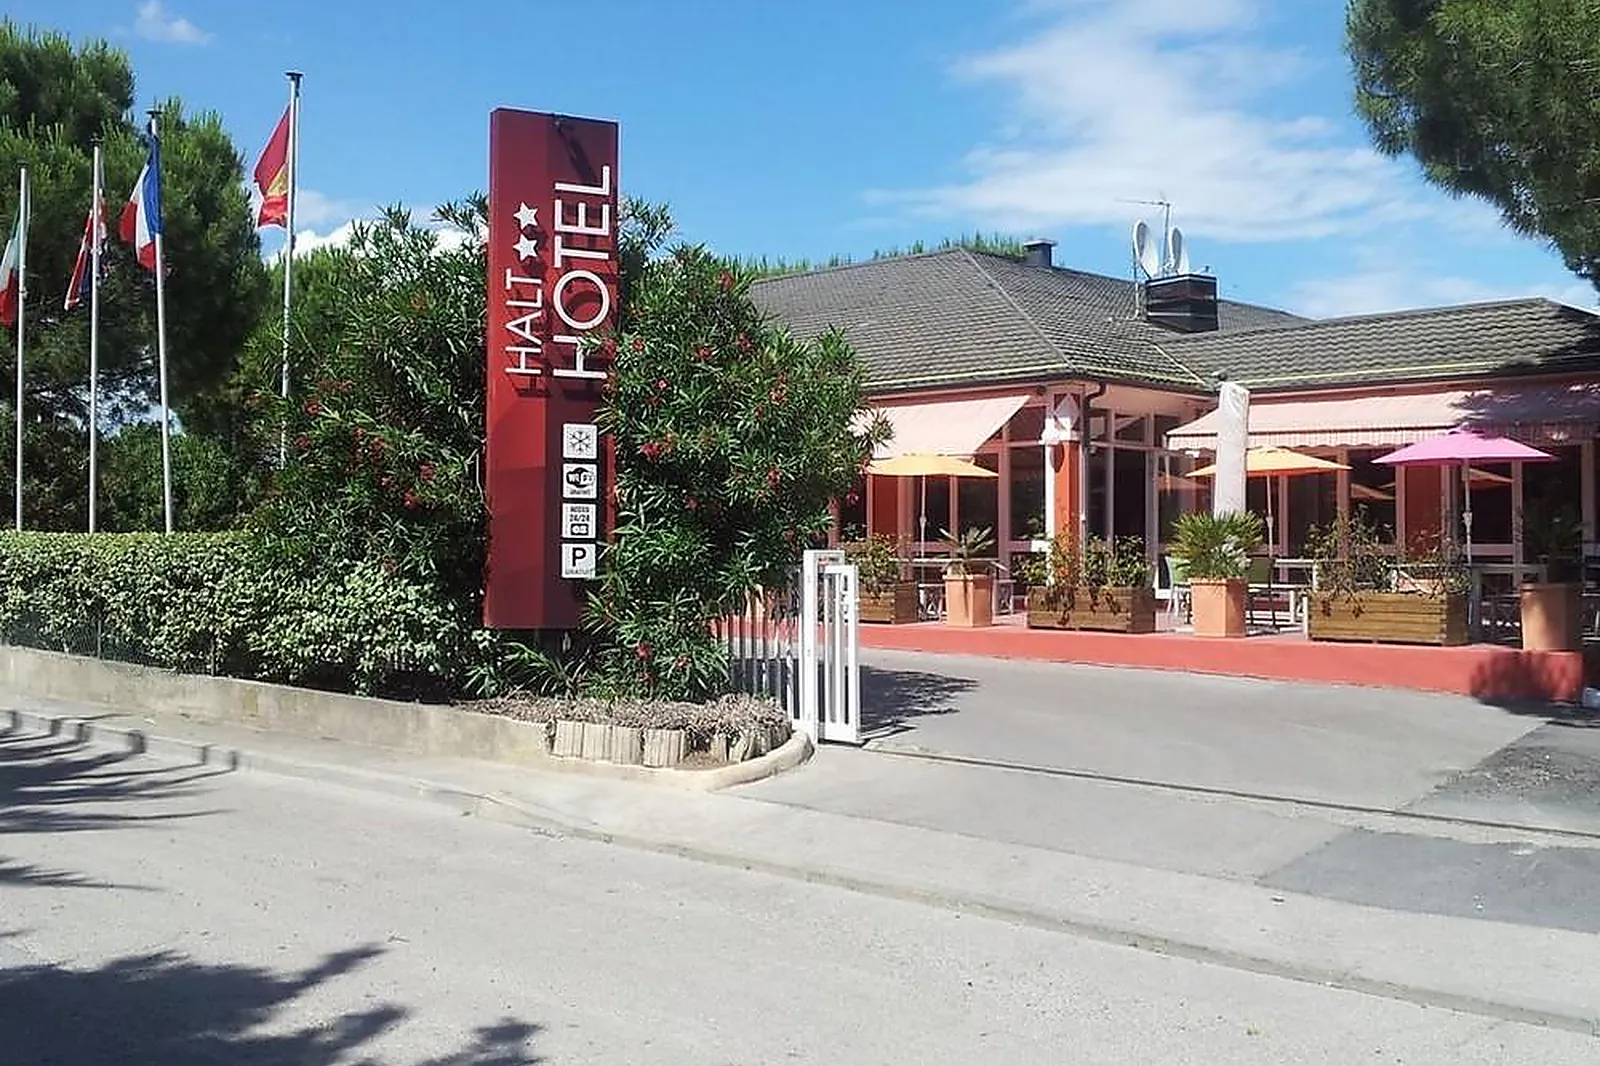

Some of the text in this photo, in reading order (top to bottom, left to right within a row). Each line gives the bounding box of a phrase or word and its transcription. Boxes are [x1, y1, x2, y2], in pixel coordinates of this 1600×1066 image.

[505, 268, 543, 375] HALT
[553, 165, 610, 379] HOTEL
[572, 547, 586, 567] P
